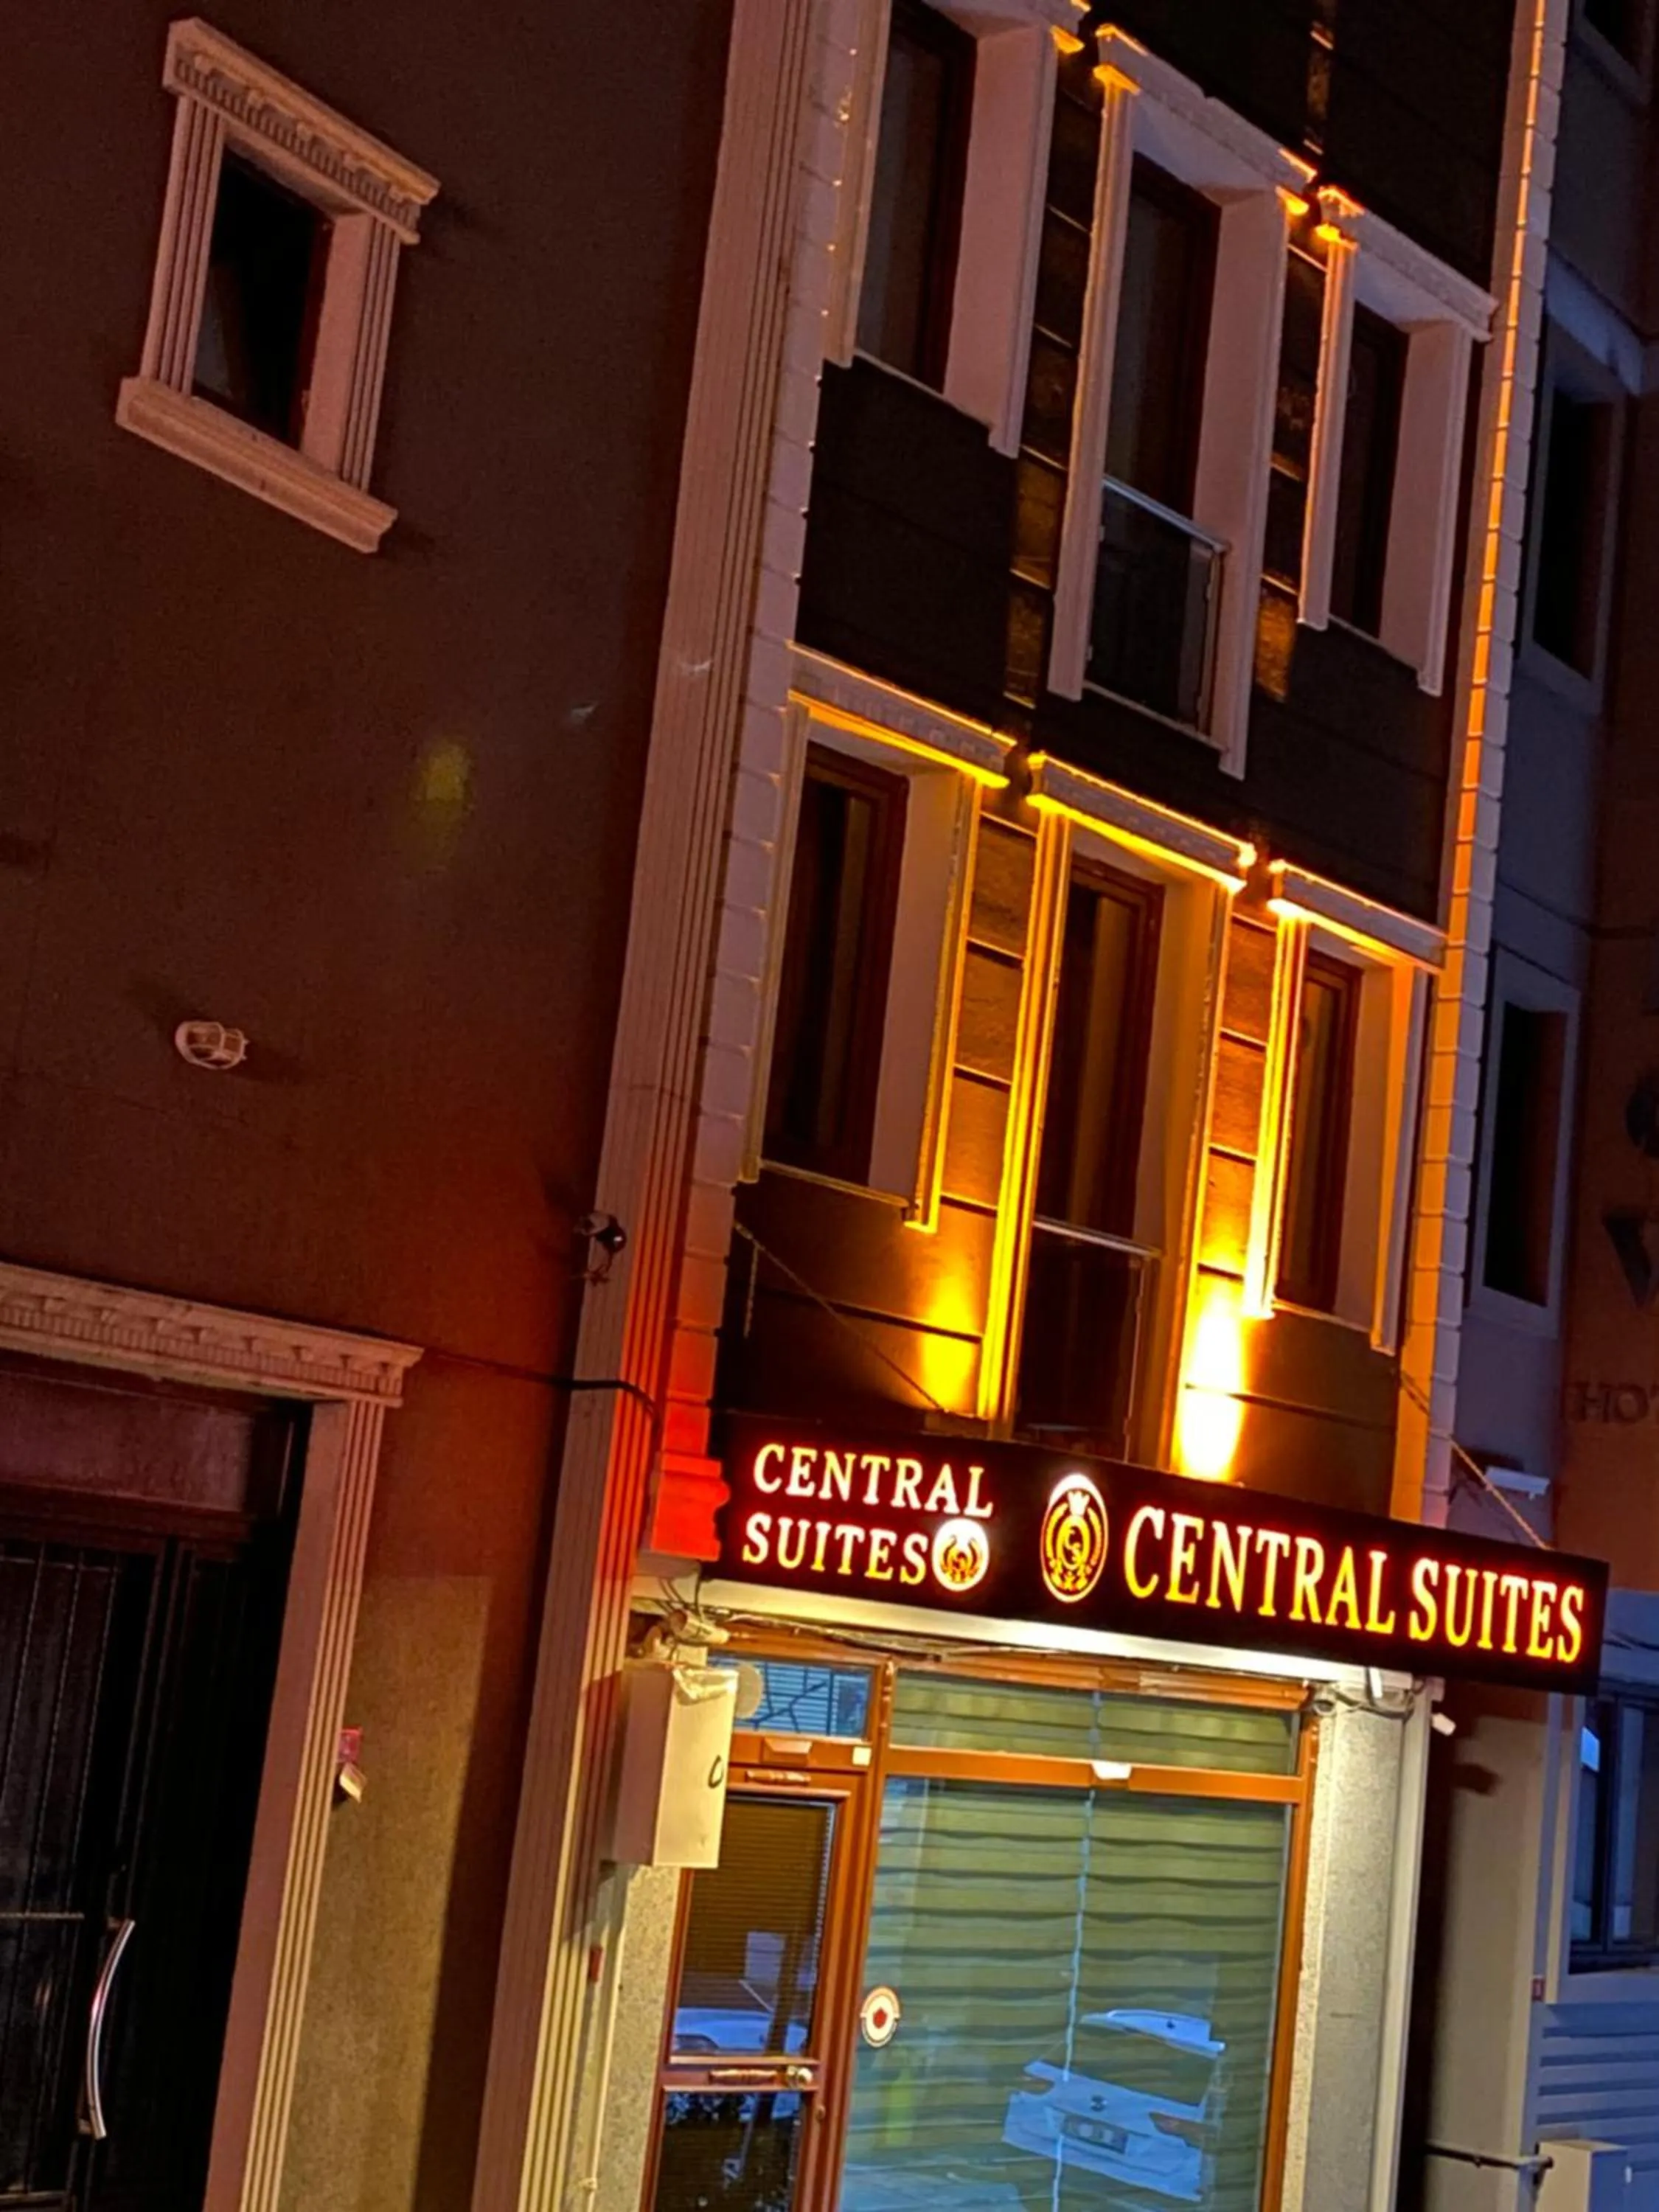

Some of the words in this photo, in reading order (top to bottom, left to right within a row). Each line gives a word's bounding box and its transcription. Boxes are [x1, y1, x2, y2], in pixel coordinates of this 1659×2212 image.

[1571, 1380, 1659, 1426] HO
[753, 1443, 994, 1518] CENTRAL
[741, 1512, 929, 1585] SUITES
[1124, 1505, 1396, 1635] CENTRAL
[1409, 1557, 1584, 1663] SUITES
